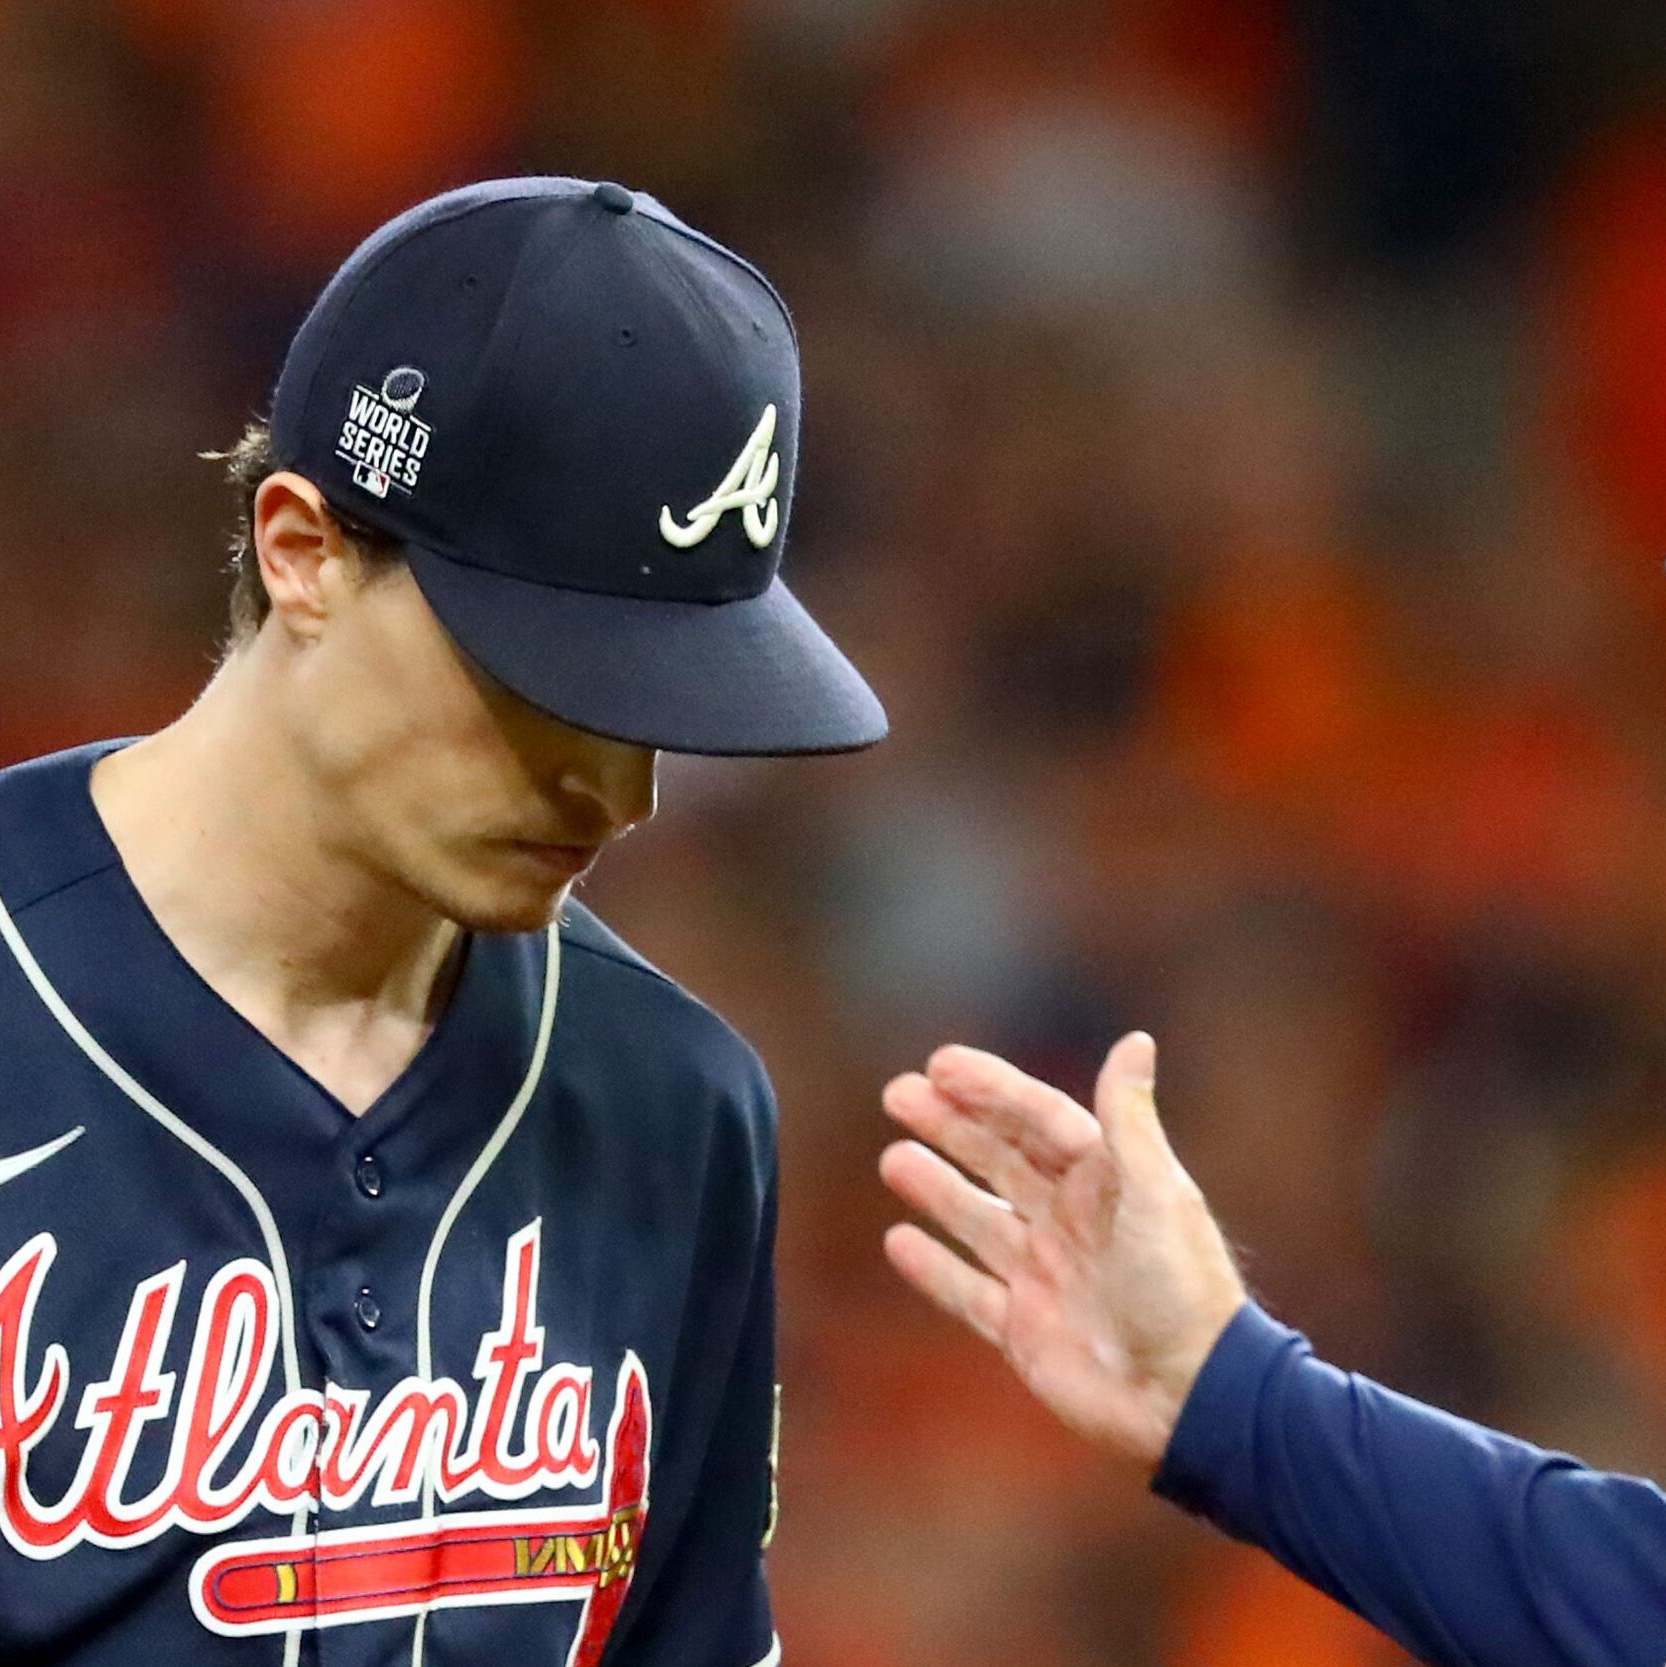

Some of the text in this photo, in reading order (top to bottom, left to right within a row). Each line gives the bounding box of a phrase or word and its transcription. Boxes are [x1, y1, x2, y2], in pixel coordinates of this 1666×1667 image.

[338, 421, 422, 487] SERIES
[349, 390, 430, 459] WORLD
[659, 403, 779, 548] A
